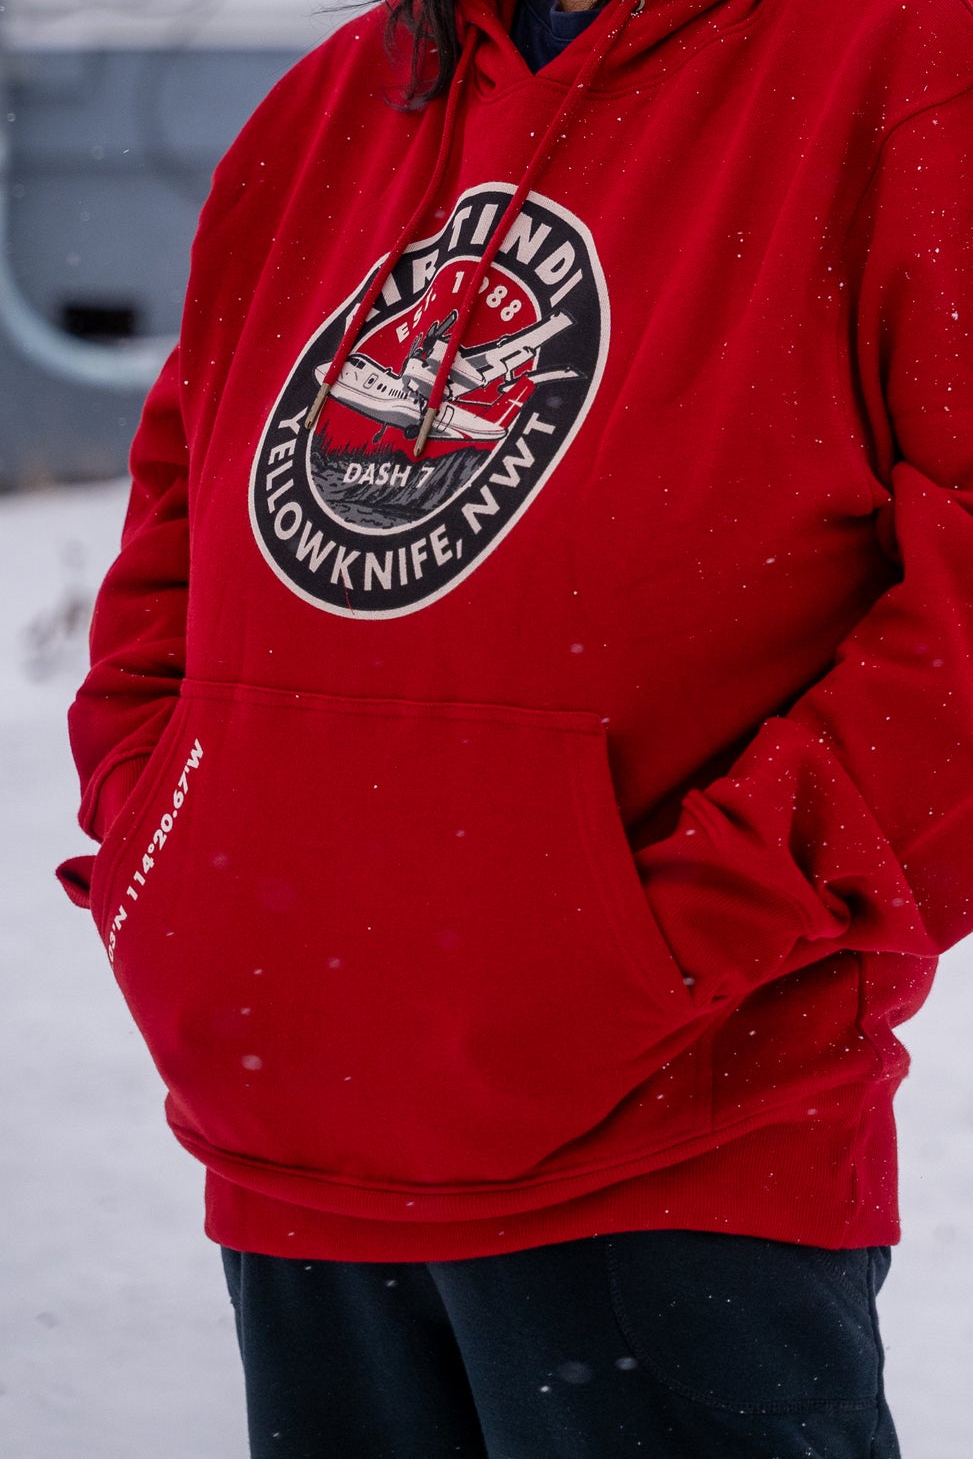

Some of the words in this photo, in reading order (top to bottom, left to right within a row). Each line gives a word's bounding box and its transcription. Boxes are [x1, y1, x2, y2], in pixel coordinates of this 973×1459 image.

[448, 204, 584, 309] TINDI
[265, 405, 465, 591] YELLOWKNIFE,
[461, 411, 558, 536] NWT
[342, 462, 412, 487] DASH
[416, 466, 435, 488] 7
